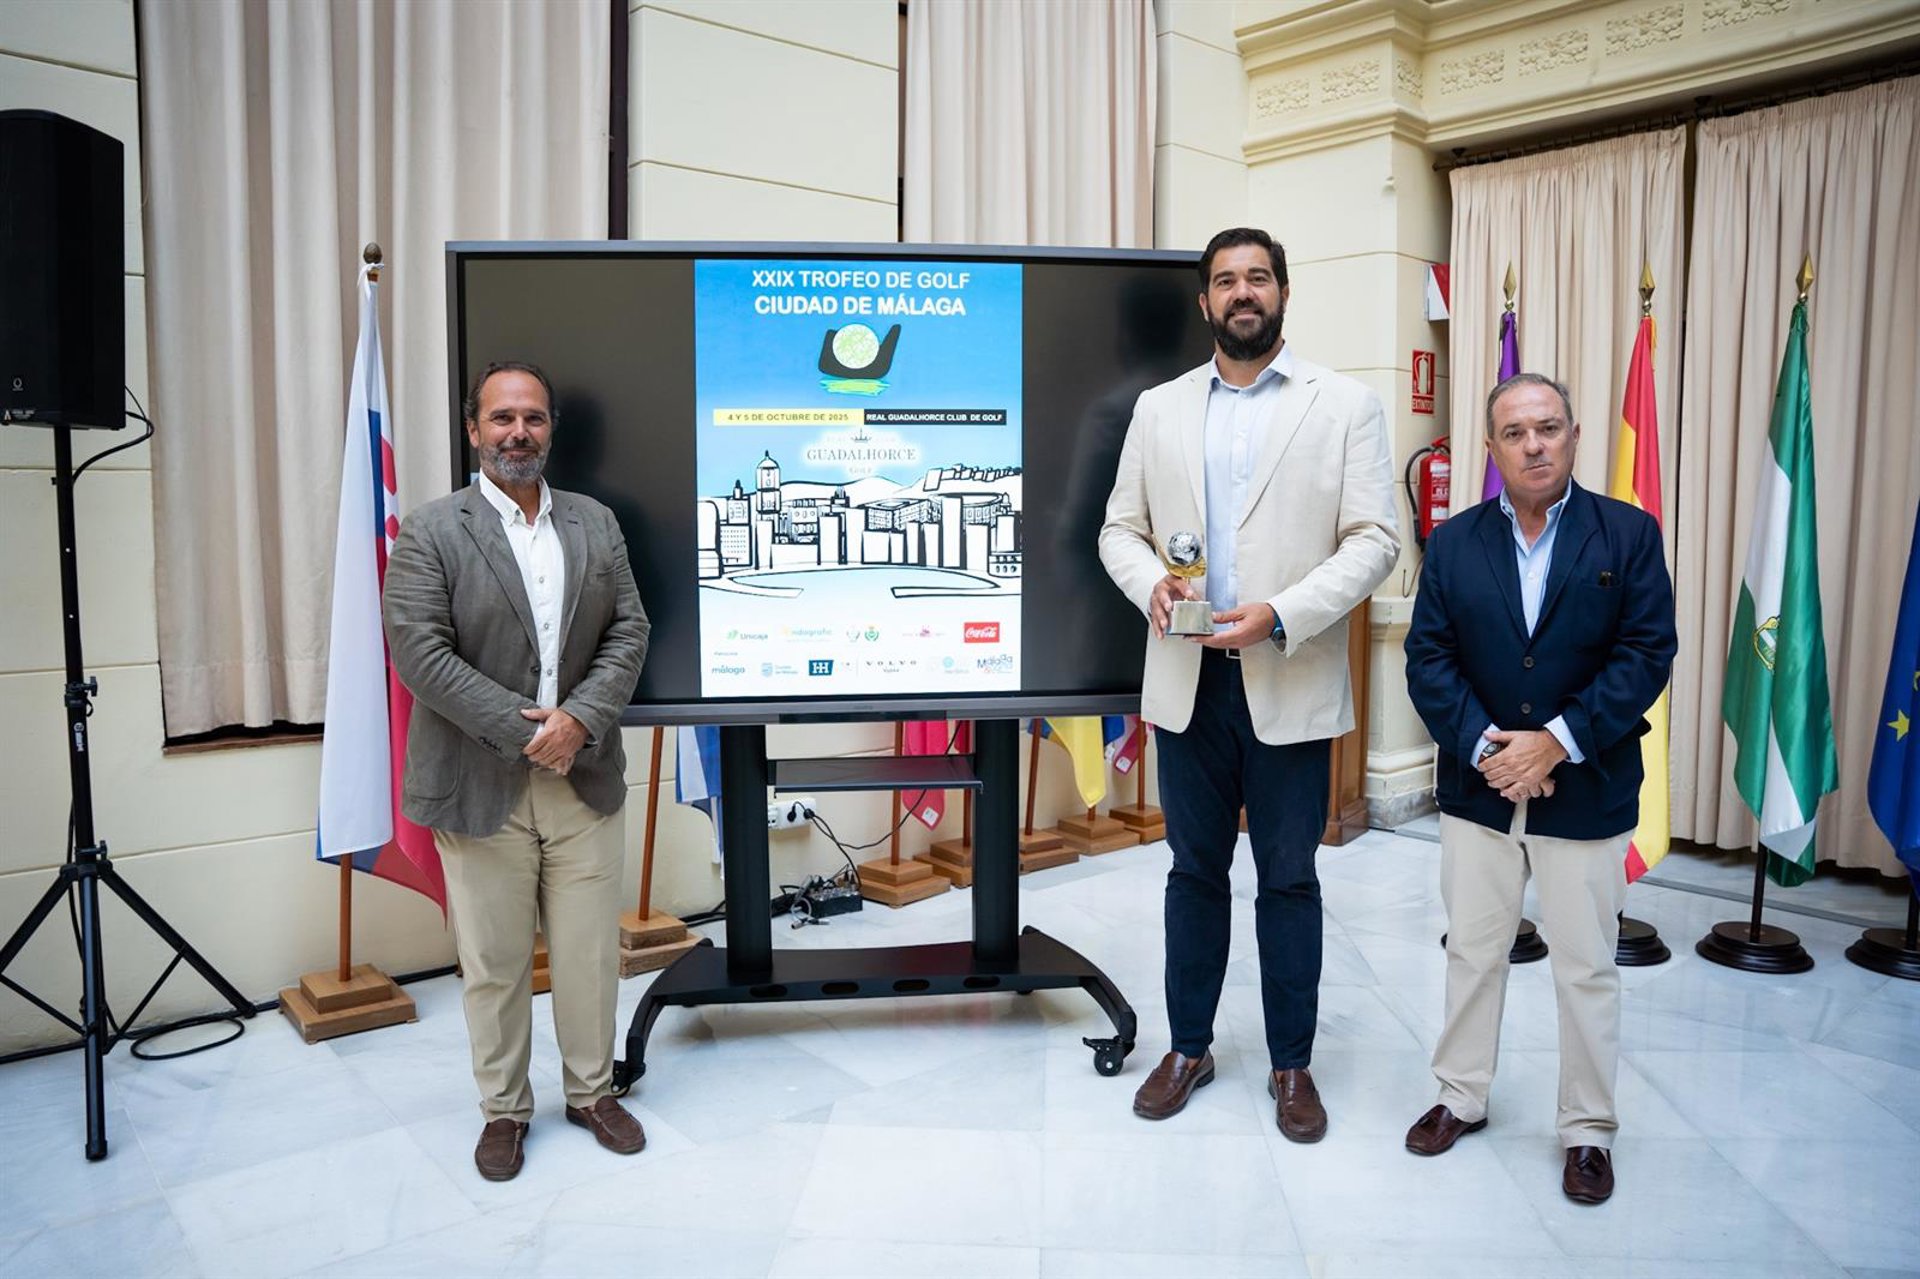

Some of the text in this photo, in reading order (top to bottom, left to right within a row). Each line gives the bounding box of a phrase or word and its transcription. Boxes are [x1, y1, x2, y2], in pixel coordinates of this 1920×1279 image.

[752, 270, 970, 289] XXIX TROFEO DE GOLF
[754, 293, 966, 316] CIUDAD DE MÁLAGA
[736, 413, 742, 421] Y
[752, 413, 763, 421] DE
[767, 413, 811, 421] OCTUBRE
[814, 413, 825, 421] DE
[828, 413, 849, 421] 2025
[866, 413, 1002, 422] REAL GUADALHORCE CLUB DE GOLF
[806, 448, 916, 461] GUADALHORCE
